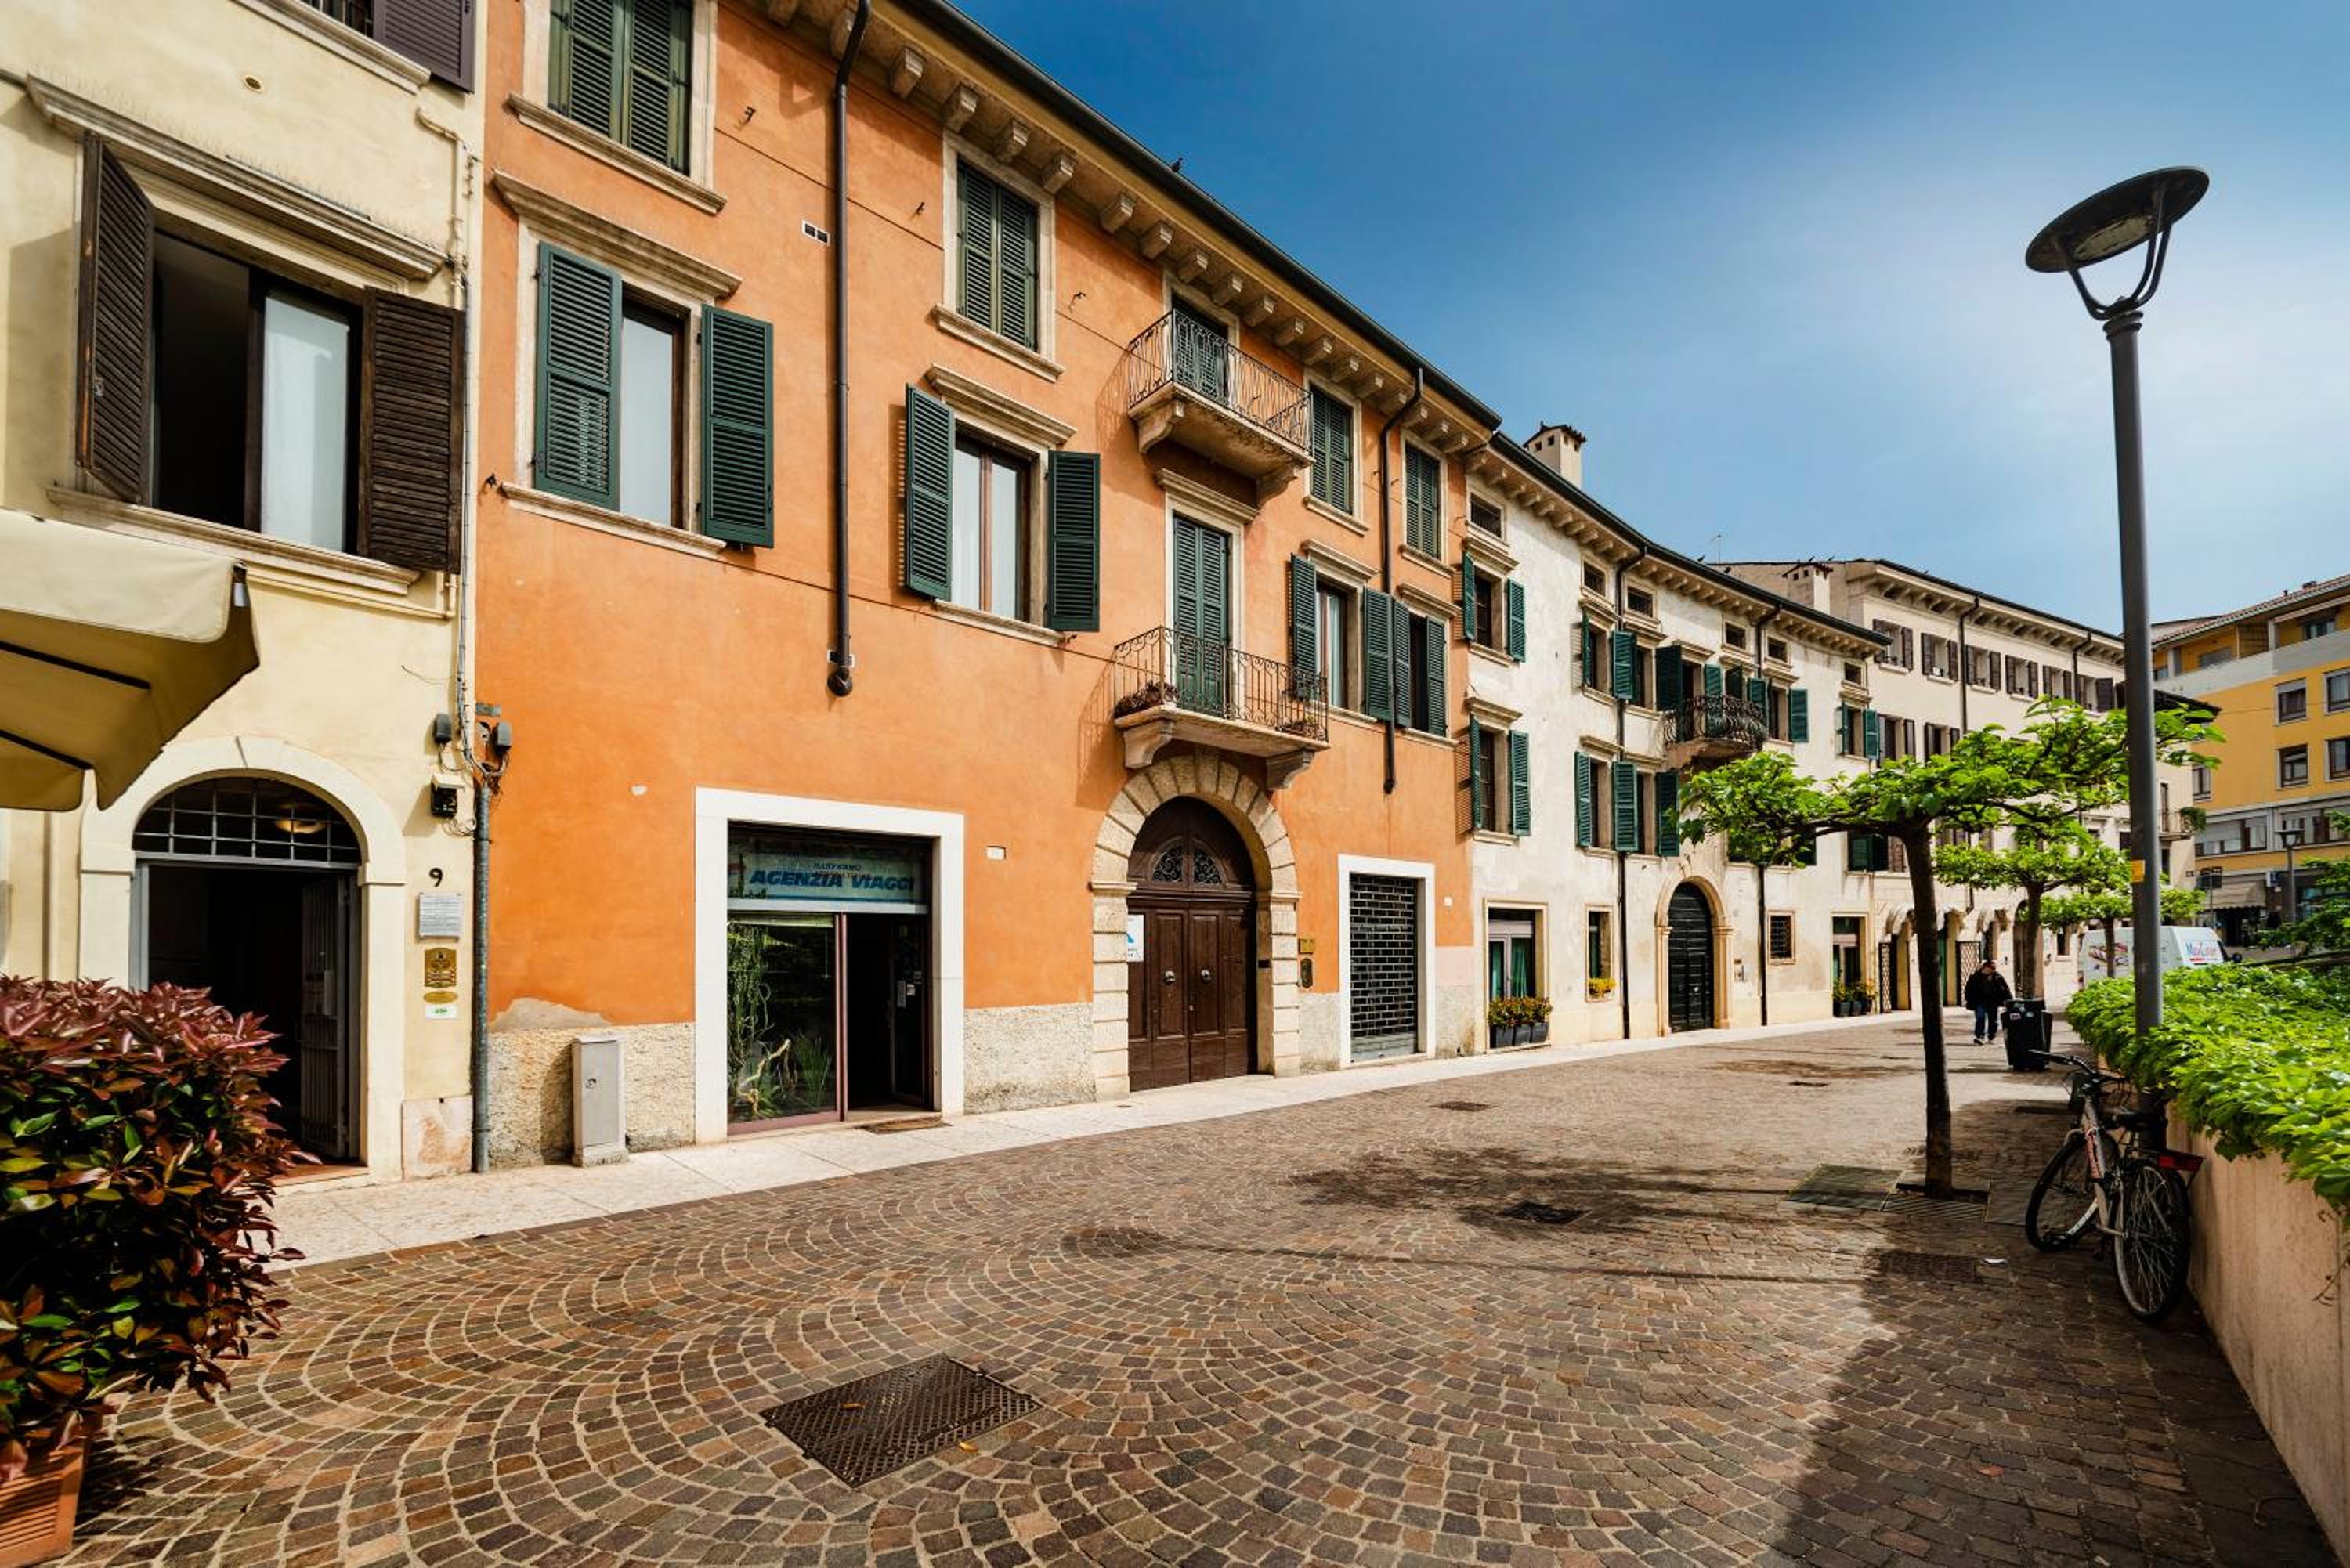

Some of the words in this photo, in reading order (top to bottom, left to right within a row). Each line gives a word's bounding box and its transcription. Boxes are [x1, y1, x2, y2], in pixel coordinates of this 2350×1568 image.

[428, 867, 443, 887] 9
[750, 870, 842, 887] AGENZIA
[851, 875, 915, 891] VIAGGI
